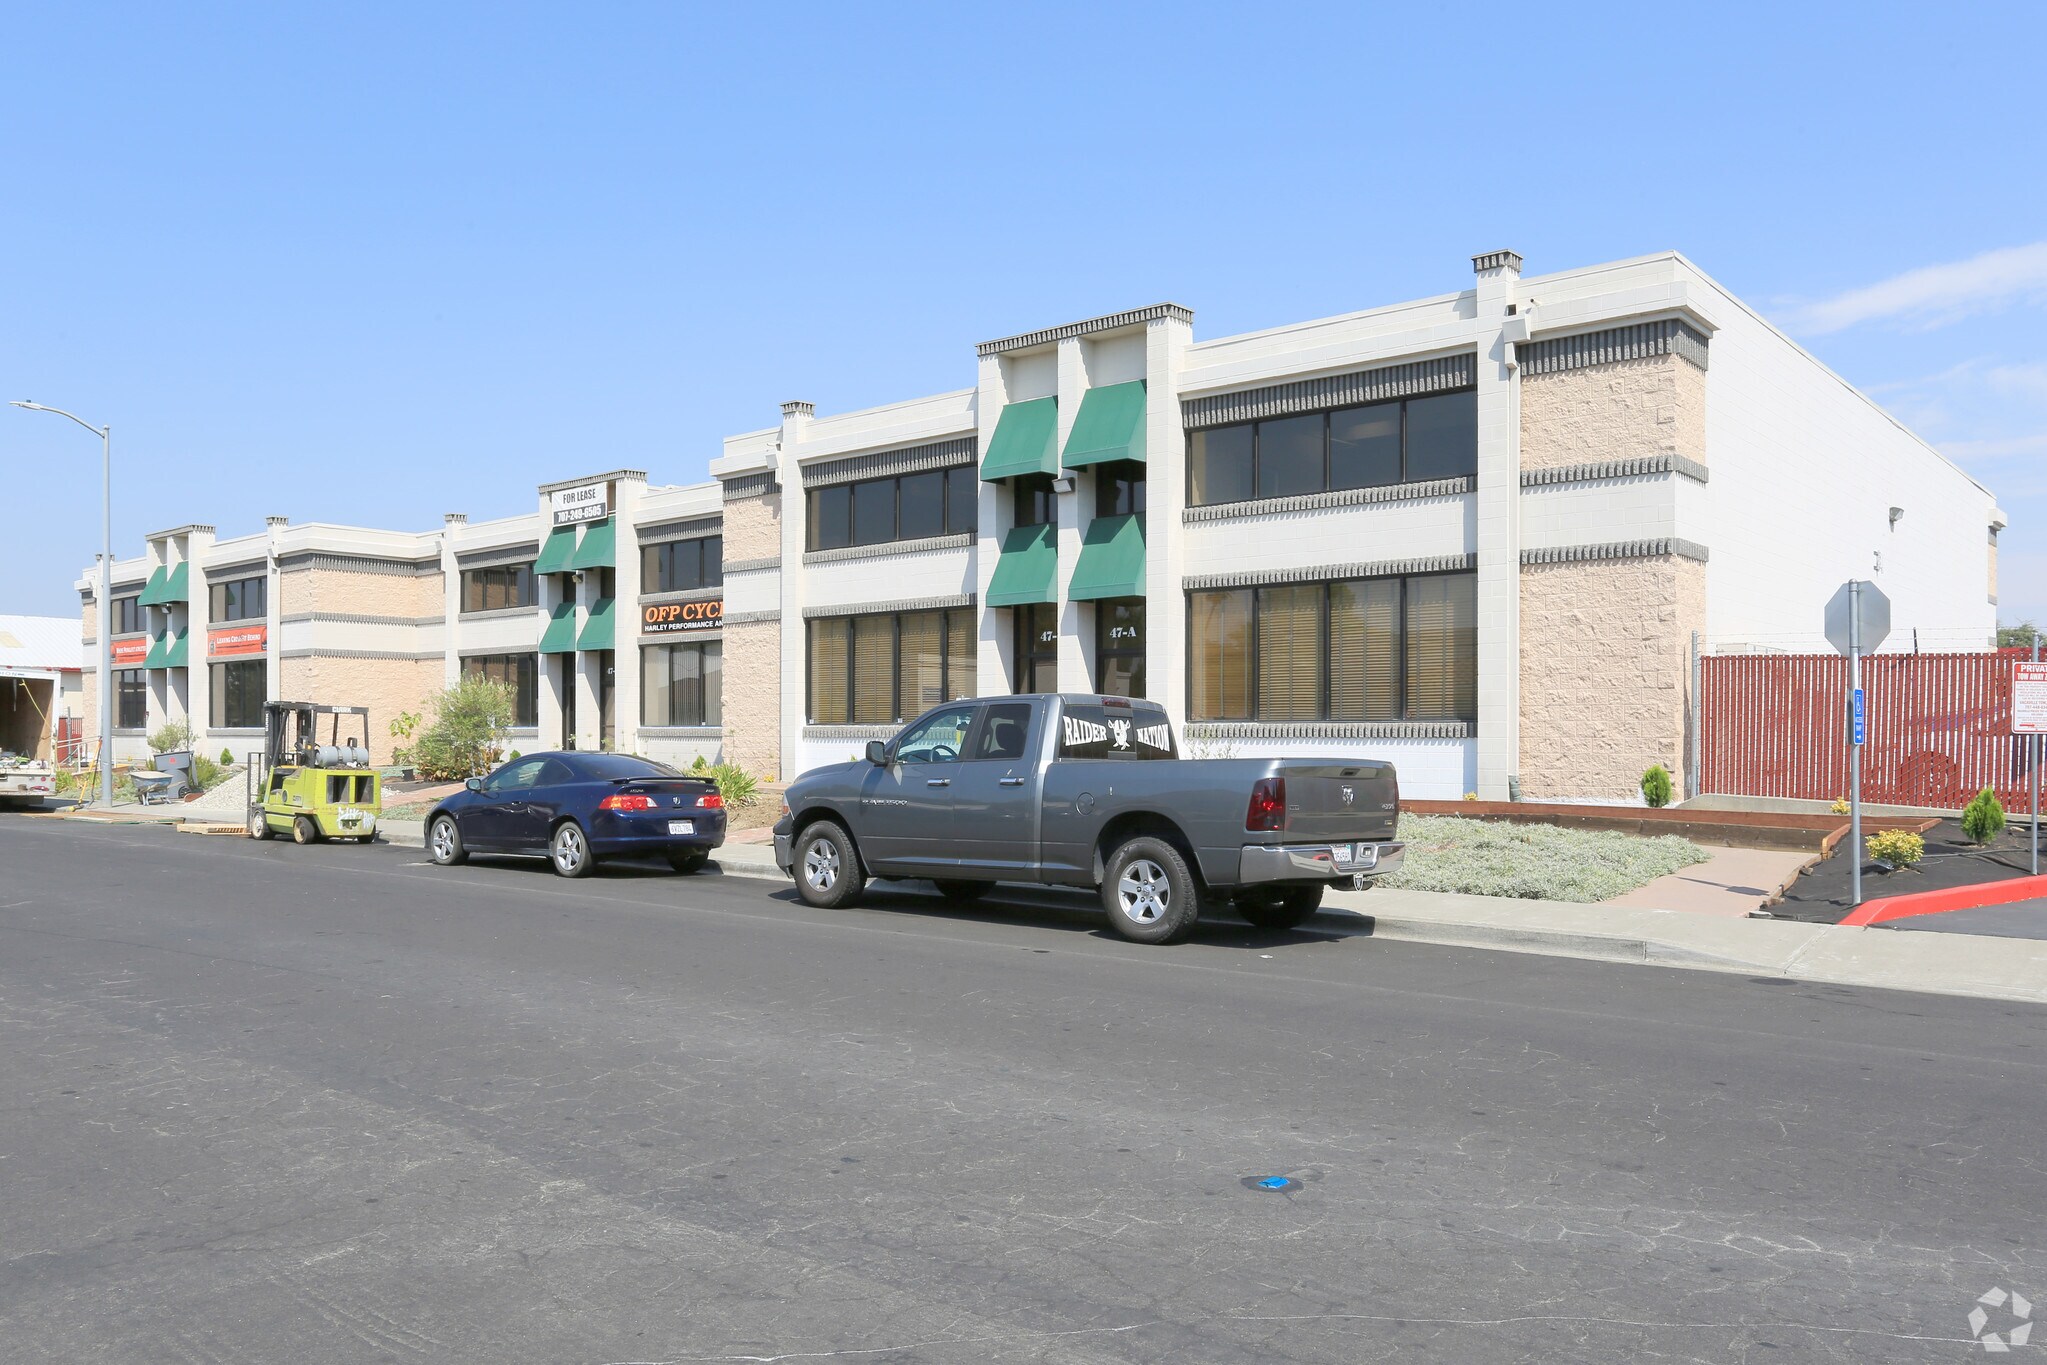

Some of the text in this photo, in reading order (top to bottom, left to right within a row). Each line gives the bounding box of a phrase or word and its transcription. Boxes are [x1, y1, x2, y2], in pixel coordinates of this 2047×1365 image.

[563, 488, 596, 504] FOR LEASE
[557, 505, 602, 522] 707-249-6505
[645, 605, 680, 623] OFP
[644, 623, 667, 632] HARLEY
[668, 620, 714, 631] PERFORMANCE
[1109, 626, 1137, 638] 47-A
[2017, 672, 2029, 681] TOW
[1063, 716, 1170, 752] RAIDER NATION
